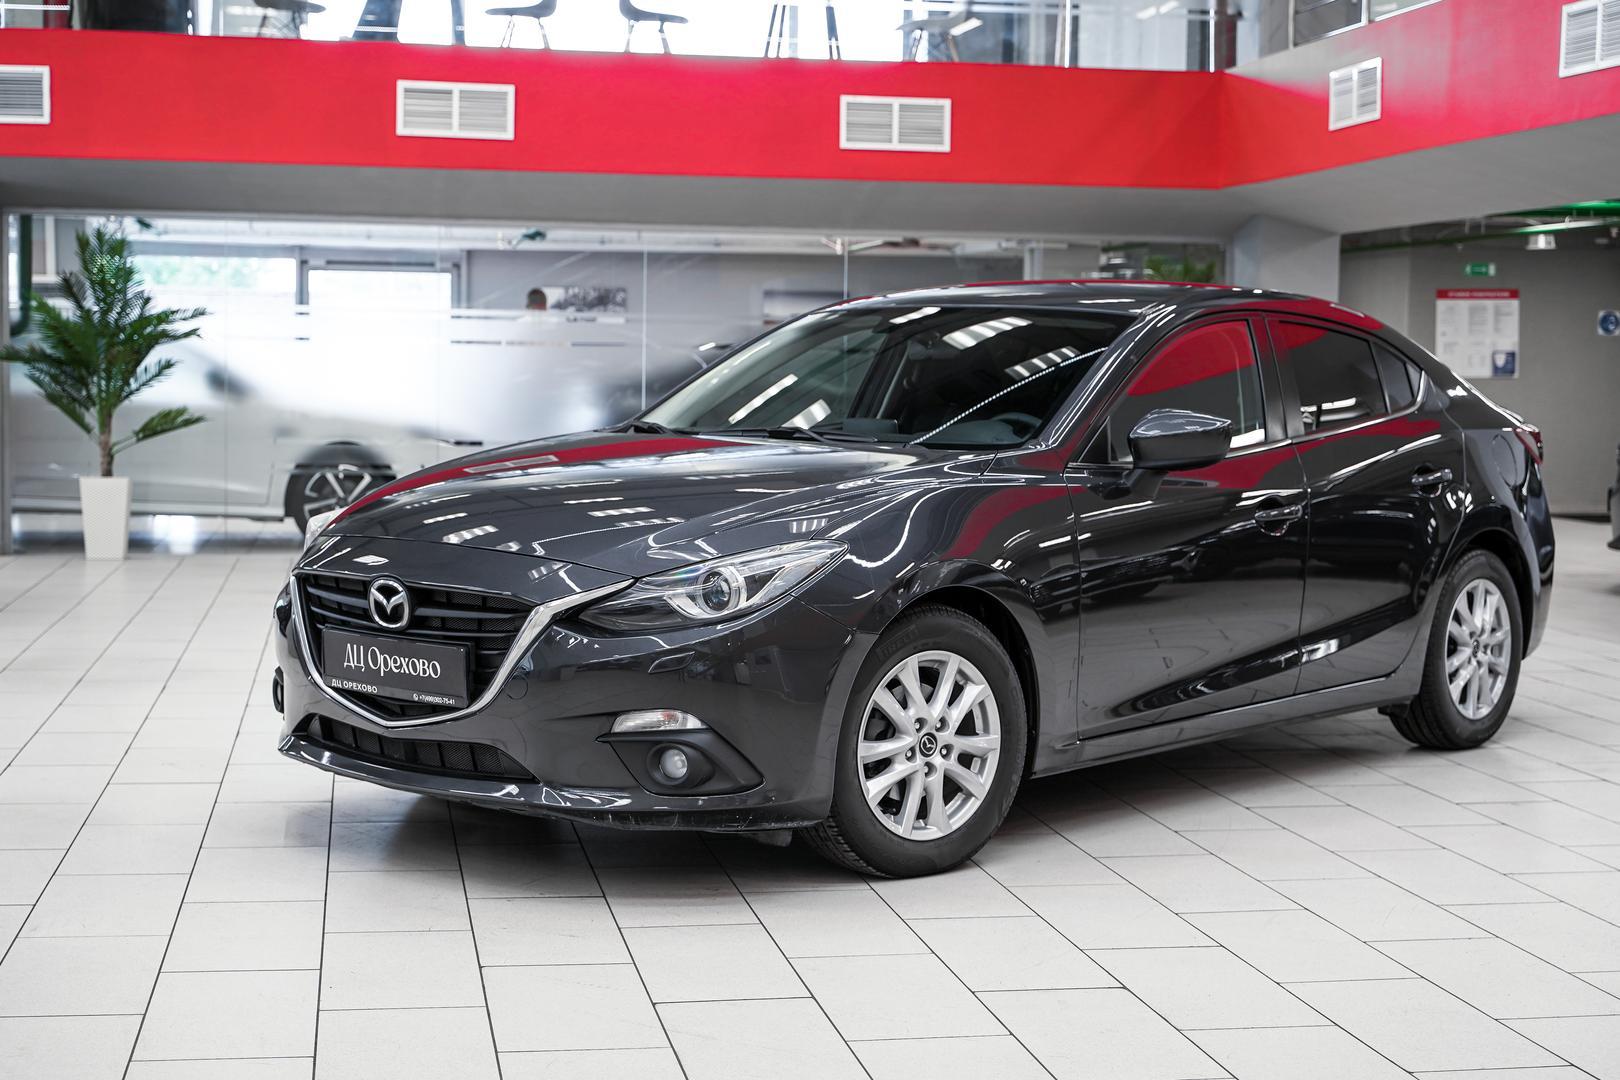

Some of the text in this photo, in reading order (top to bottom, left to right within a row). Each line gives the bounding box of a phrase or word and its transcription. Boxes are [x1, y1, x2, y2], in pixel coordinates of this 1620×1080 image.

[344, 643, 441, 678] ДЦ Орехово
[331, 679, 378, 693] ДЦ ОРЕХОВО
